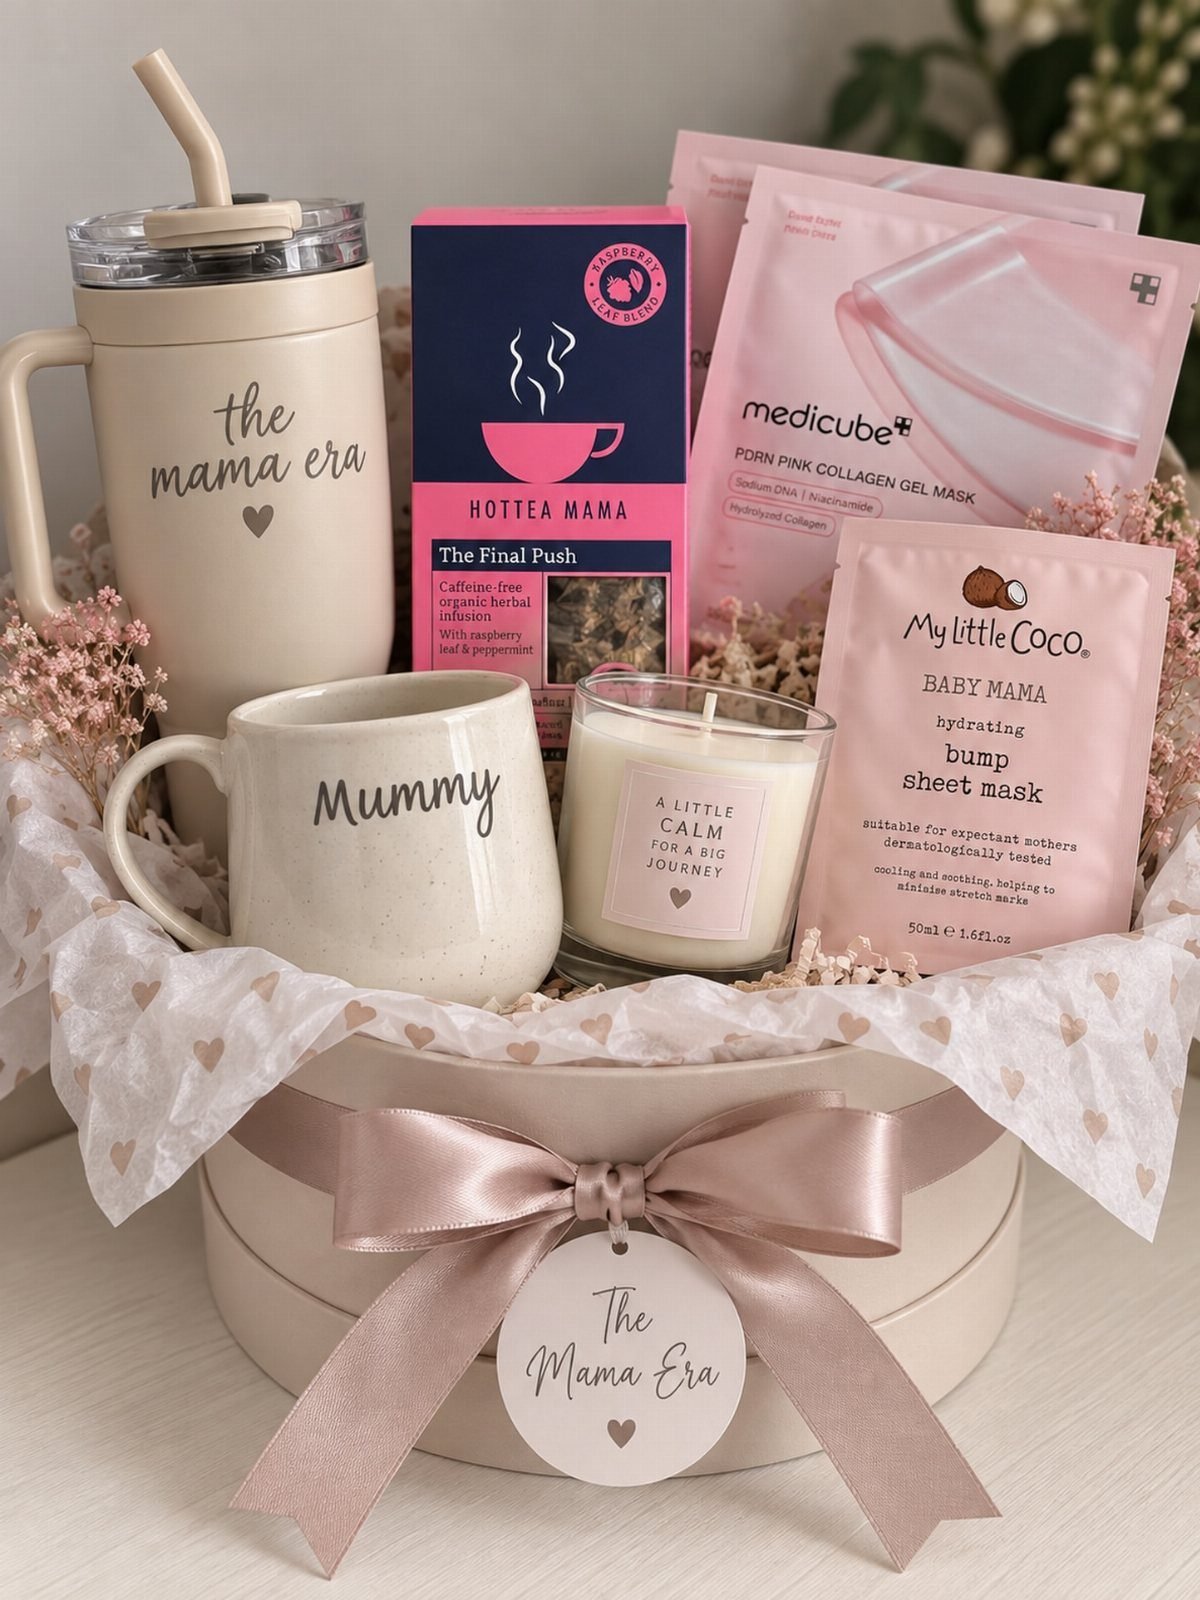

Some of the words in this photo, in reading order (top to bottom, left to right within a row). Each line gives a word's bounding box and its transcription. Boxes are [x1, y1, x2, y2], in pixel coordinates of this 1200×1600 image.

[592, 297, 620, 321] LEAF
[624, 296, 659, 322] BLEND
[214, 381, 295, 446] the
[742, 401, 893, 445] medicube
[151, 453, 291, 499] mama
[305, 440, 366, 479] era
[735, 447, 775, 466] PDRN
[778, 455, 812, 473] PINK
[816, 463, 896, 489] COLLAGEN
[900, 480, 929, 496] GEL
[933, 485, 976, 505] MASK
[735, 477, 772, 494] Sodium
[774, 485, 798, 498] DNA
[808, 492, 874, 514] Niacinamide
[470, 500, 551, 519] HOTTEA
[564, 500, 627, 520] MAMA
[729, 503, 783, 522] Hydrolyzed
[784, 513, 827, 531] Collagen
[439, 547, 474, 563] The
[480, 547, 525, 563] Final
[532, 547, 577, 564] Push
[439, 581, 523, 593] Caffeine-free
[439, 597, 487, 610] organic
[491, 596, 531, 608] herbal
[439, 609, 492, 622] infusion
[439, 630, 467, 640] With
[470, 632, 522, 644] raspberry
[903, 613, 946, 649] My
[953, 615, 1006, 648] Little
[439, 643, 459, 655] leaf
[461, 644, 470, 654] &
[472, 645, 534, 658] peppermint
[922, 674, 982, 697] BABY
[986, 680, 1048, 704] MAMA
[936, 715, 1025, 738] hydrating
[945, 744, 1009, 773] bump
[902, 771, 972, 795] sheet
[980, 782, 1043, 804] mask
[313, 769, 500, 838] Mummy
[655, 796, 665, 808] A
[674, 799, 734, 819] LITTLE
[660, 817, 723, 840] CALM
[863, 818, 920, 834] suitable
[925, 824, 947, 837] for
[951, 828, 1020, 845] expectant
[1024, 837, 1078, 853] mothers
[651, 839, 678, 853] FOR
[684, 845, 693, 856] A
[700, 847, 726, 860] BIG
[883, 837, 1004, 862] dermatologically
[1009, 851, 1052, 867] tested
[646, 857, 723, 878] JOURNEY
[874, 865, 916, 879] cooling
[919, 871, 939, 881] and
[1043, 885, 1056, 895] to
[949, 889, 993, 902] stretch
[908, 922, 940, 937] 50ml
[959, 929, 1012, 946] 1.6fl.oz
[592, 1286, 654, 1344] The
[525, 1342, 642, 1400] Mama
[653, 1342, 720, 1400] Era
